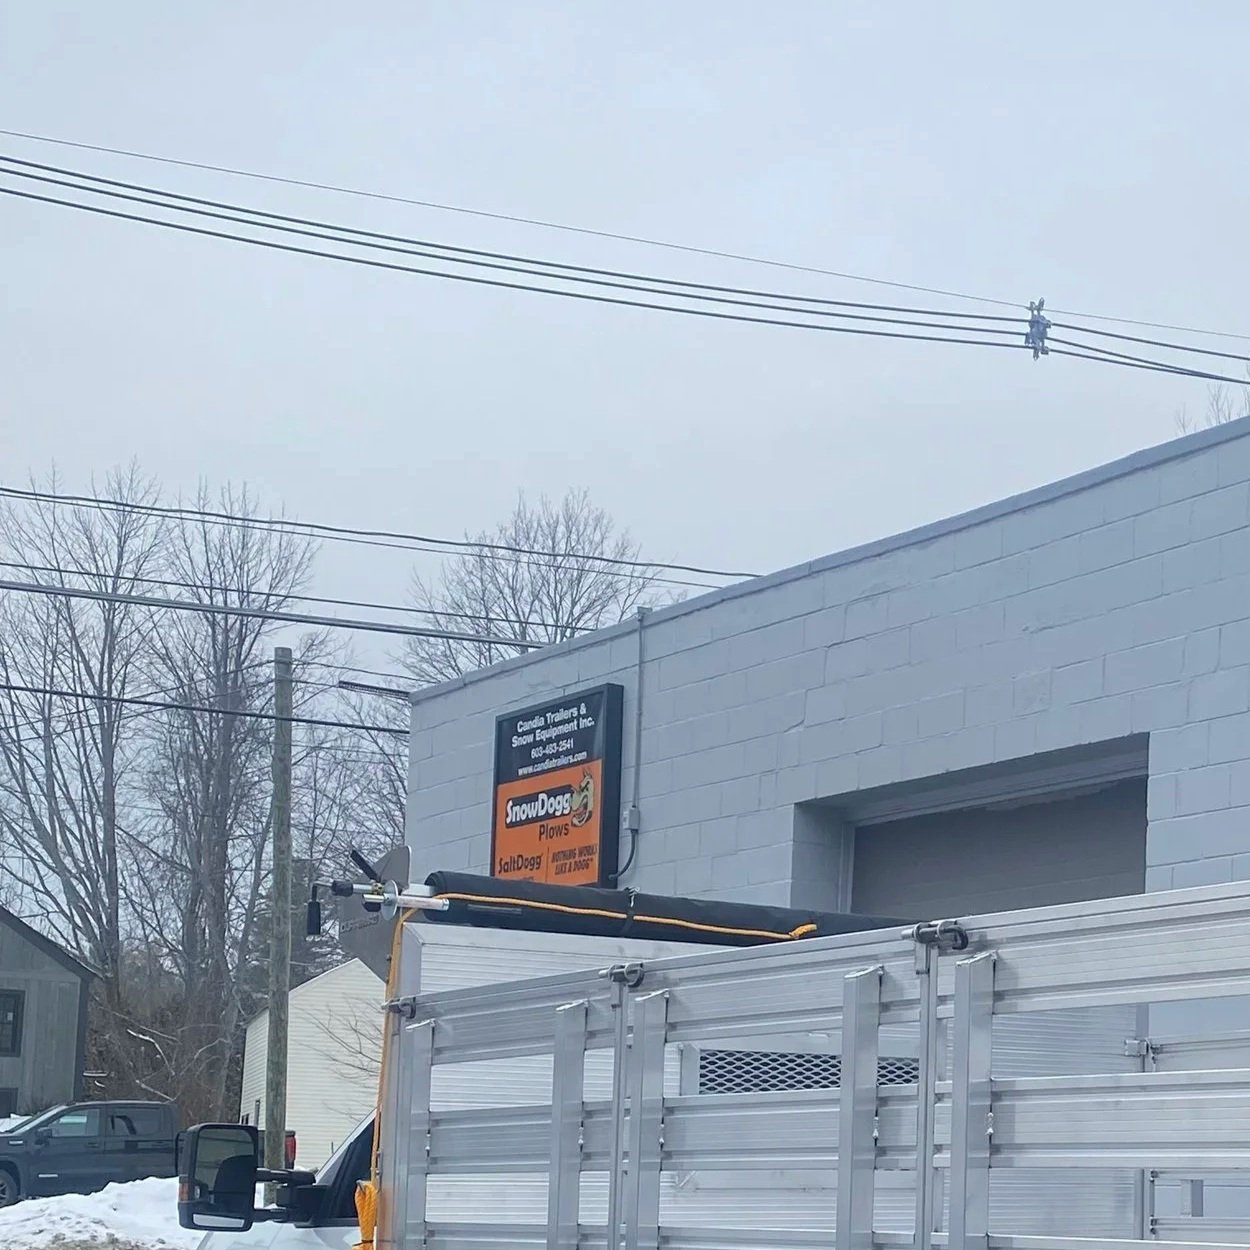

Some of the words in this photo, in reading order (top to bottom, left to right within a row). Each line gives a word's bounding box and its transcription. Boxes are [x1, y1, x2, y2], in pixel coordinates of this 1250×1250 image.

[517, 716, 544, 733] Candia
[546, 707, 578, 724] Trailers
[580, 703, 586, 714] &
[512, 733, 534, 747] Snow
[536, 719, 578, 741] Equipment
[579, 717, 594, 729] Inc.
[531, 738, 574, 759] 603-483-2541
[506, 793, 571, 824] SnowDogg
[539, 823, 569, 841] Plows
[498, 854, 542, 874] SaltDogg
